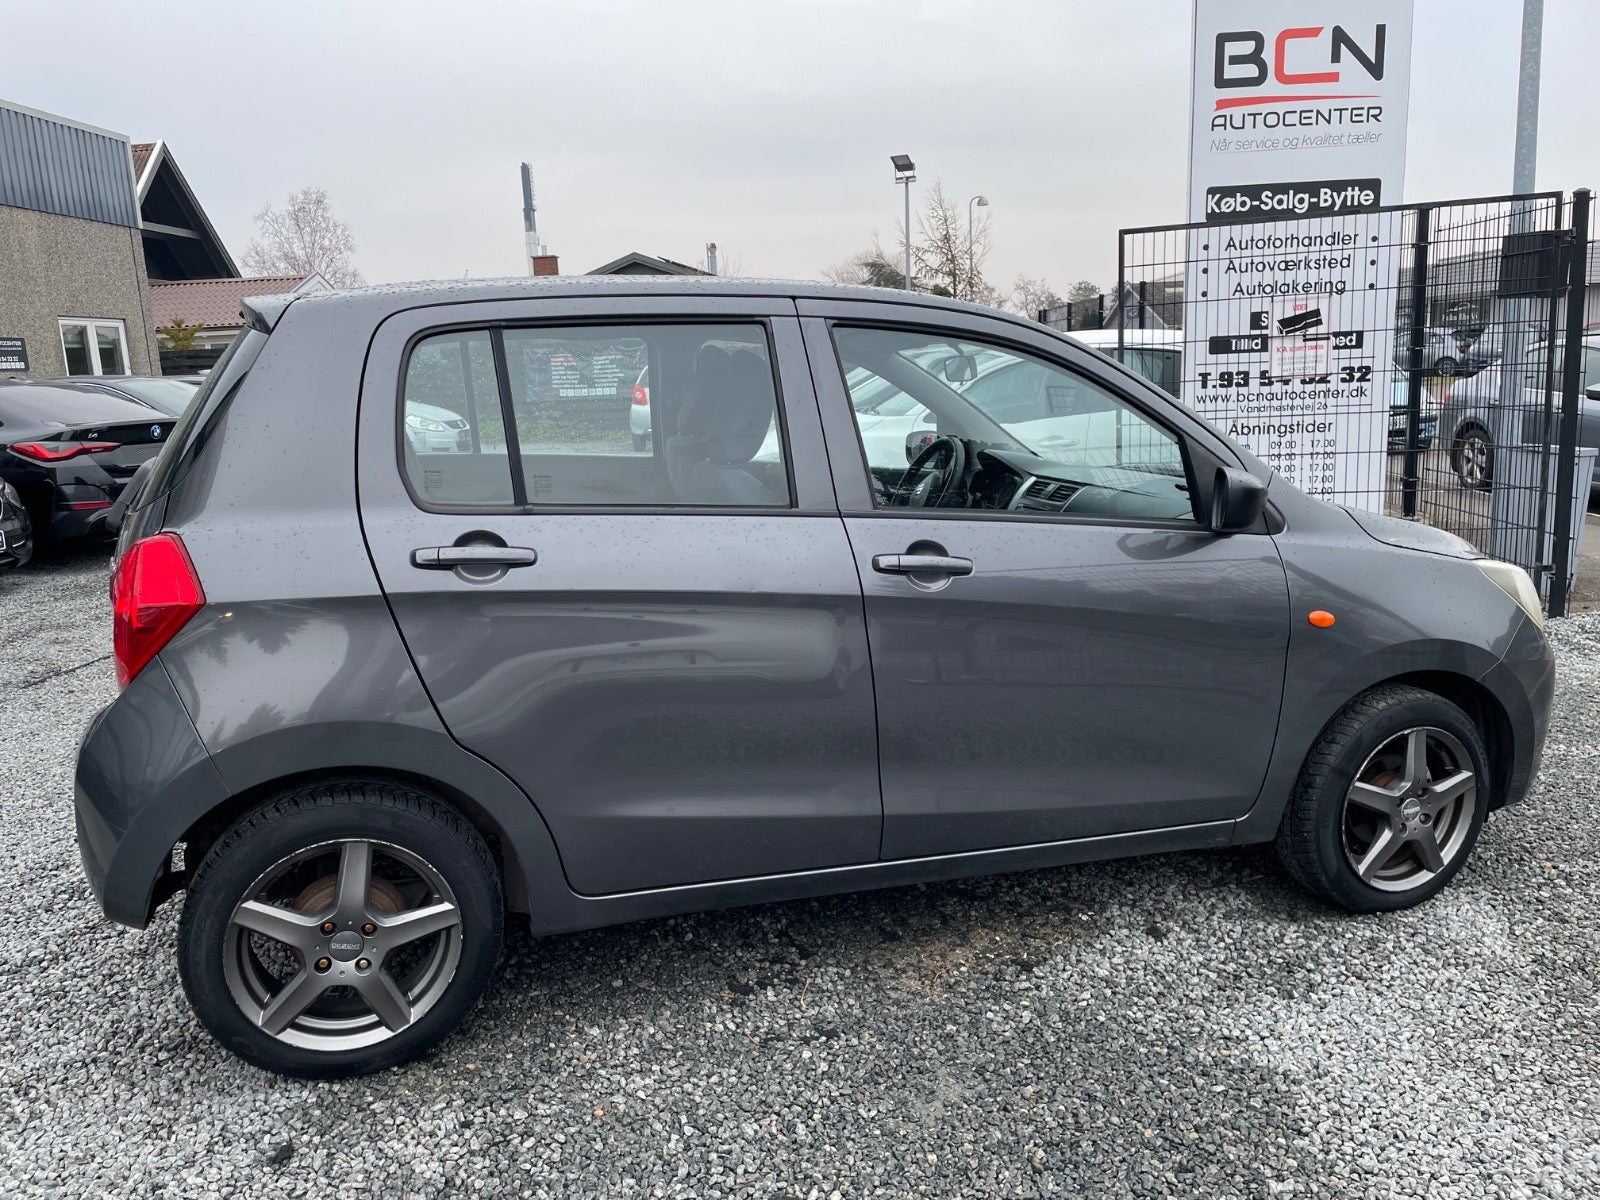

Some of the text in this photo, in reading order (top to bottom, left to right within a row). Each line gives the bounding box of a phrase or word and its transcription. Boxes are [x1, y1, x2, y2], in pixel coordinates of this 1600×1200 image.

[1214, 24, 1386, 88] BCN
[1211, 106, 1383, 131] AUTOCENTER
[1210, 131, 1383, 151] Når service og kvalitet tæller
[1207, 187, 1375, 214] Køb-Salg-Bytte
[1225, 231, 1359, 251] Autoforhandler
[1225, 254, 1351, 274] Autoværksted
[1232, 278, 1346, 295] Autolakering
[1198, 371, 1250, 389] T.93
[1340, 366, 1371, 383] 32
[1196, 386, 1368, 405] www.bcnautocenter.dk
[1239, 402, 1328, 414] Vandmestervej 26
[1228, 419, 1334, 438] Åbningstider
[1270, 441, 1296, 449] 09.00
[1310, 439, 1335, 448] 17.00
[1309, 463, 1334, 472] 17.00
[1308, 475, 1333, 484] 17.00
